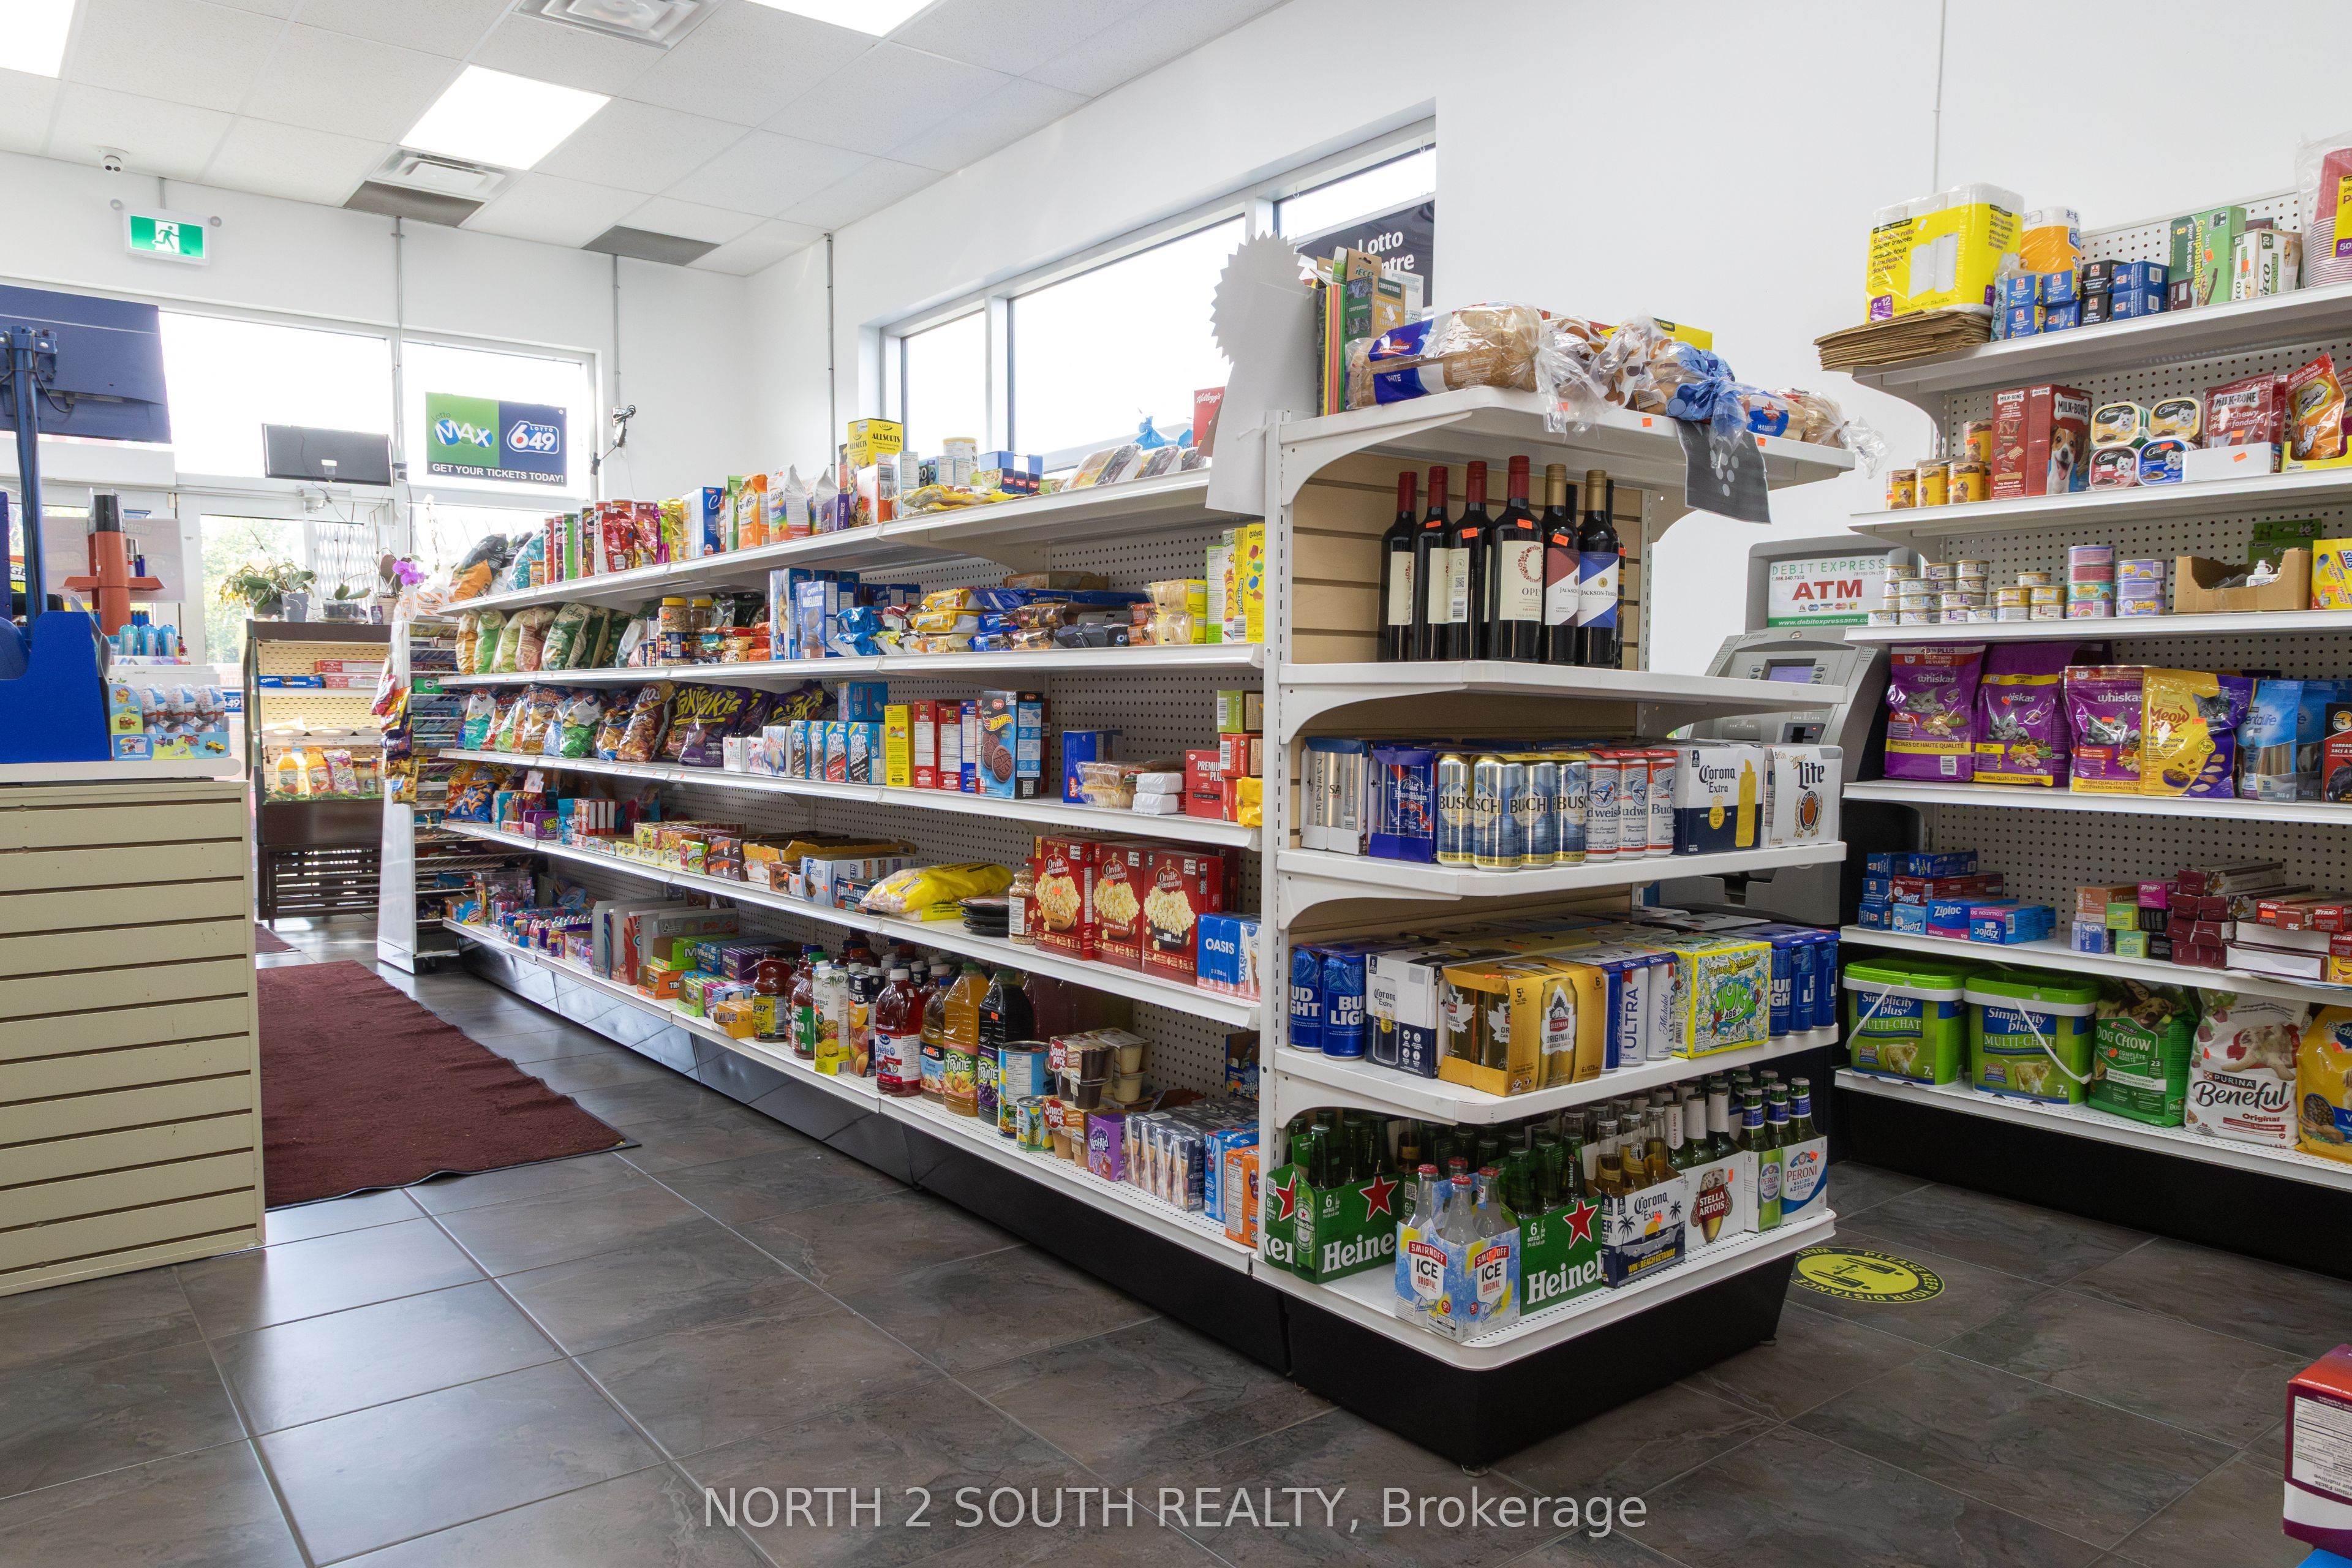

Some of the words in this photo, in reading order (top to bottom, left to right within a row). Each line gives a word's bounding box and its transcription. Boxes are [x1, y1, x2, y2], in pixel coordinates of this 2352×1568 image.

[1359, 232, 1403, 254] Lotto
[2263, 236, 2270, 246] 20
[2194, 219, 2205, 289] Compostables
[1382, 254, 1414, 271] ntre
[1379, 282, 1400, 293] COMPOSTABLE
[1197, 393, 1221, 402] Kellogg's
[872, 433, 900, 443] ALLSORTS
[432, 464, 453, 472] GET
[456, 466, 484, 476] YOUR
[486, 469, 527, 479] TICKETS
[529, 472, 564, 483] TODAY!
[1773, 563, 1814, 576] DEBIT
[1821, 559, 1885, 572] EXPRESS
[1792, 579, 1862, 600] ATM
[802, 597, 823, 608] MOELLEUX
[1779, 617, 1868, 625] www.debitexpressatm.co
[1918, 674, 1956, 683] whiskas
[946, 710, 956, 718] RITZ
[2150, 706, 2189, 722] Meow
[1699, 765, 1736, 783] Corona
[1798, 761, 1825, 790] Lite
[1709, 781, 1728, 794] Extra
[1439, 796, 1473, 810] BUSC
[1048, 858, 1064, 870] Orville
[1106, 864, 1122, 875] Orville
[1159, 872, 1177, 883] Orville
[840, 886, 864, 900] BUILDERS
[1934, 905, 1962, 918] Ziploc
[1899, 922, 1921, 932] Ziploc
[1975, 927, 2001, 940] Ziploc
[1205, 938, 1234, 955] OASIS
[1708, 965, 1728, 979] Flying
[1737, 955, 1760, 968] Monkeys
[1292, 986, 1313, 1001] UD
[1374, 987, 1396, 1001] Corona
[1291, 1003, 1321, 1017] GHT
[1379, 999, 1392, 1008] Extra
[1624, 986, 1638, 1049] ULTRA
[1659, 993, 1668, 1035] Michelob
[2117, 1023, 2137, 1035] PURINA
[1547, 1033, 1570, 1043] ORIGINAL
[2097, 1026, 2113, 1042] DOG
[2116, 1033, 2151, 1051] CHOW
[1050, 1043, 1066, 1057] Snack
[1923, 1066, 1929, 1075] 7
[2215, 1073, 2256, 1088] PURINA
[2193, 1081, 2289, 1110] Beneful
[1046, 1106, 1064, 1118] Snack
[2242, 1113, 2280, 1122] Original
[1786, 1165, 1817, 1182] PERONI
[1790, 1182, 1814, 1193] AZZURRO
[1325, 1195, 1332, 1207] 6
[1635, 1192, 1668, 1214] Corona
[1699, 1192, 1725, 1207] STELLA
[1698, 1202, 1725, 1217] ARTOIS
[1411, 1245, 1445, 1265] SMIRNOFF
[1628, 1263, 1638, 1273] WIN
[1640, 1257, 1654, 1268] BEACH
[1655, 1248, 1676, 1262] GETAWAY
[1416, 1259, 1438, 1279] ICE
[1864, 1252, 1924, 1273] PLEASE
[1417, 1275, 1436, 1289] ORIGINAL
[1483, 1279, 1499, 1295] ORIGINAL
[1921, 1273, 1939, 1290] KEEP
[1795, 1278, 1887, 1301] DISTANCE
[1893, 1289, 1934, 1300] YOUR
